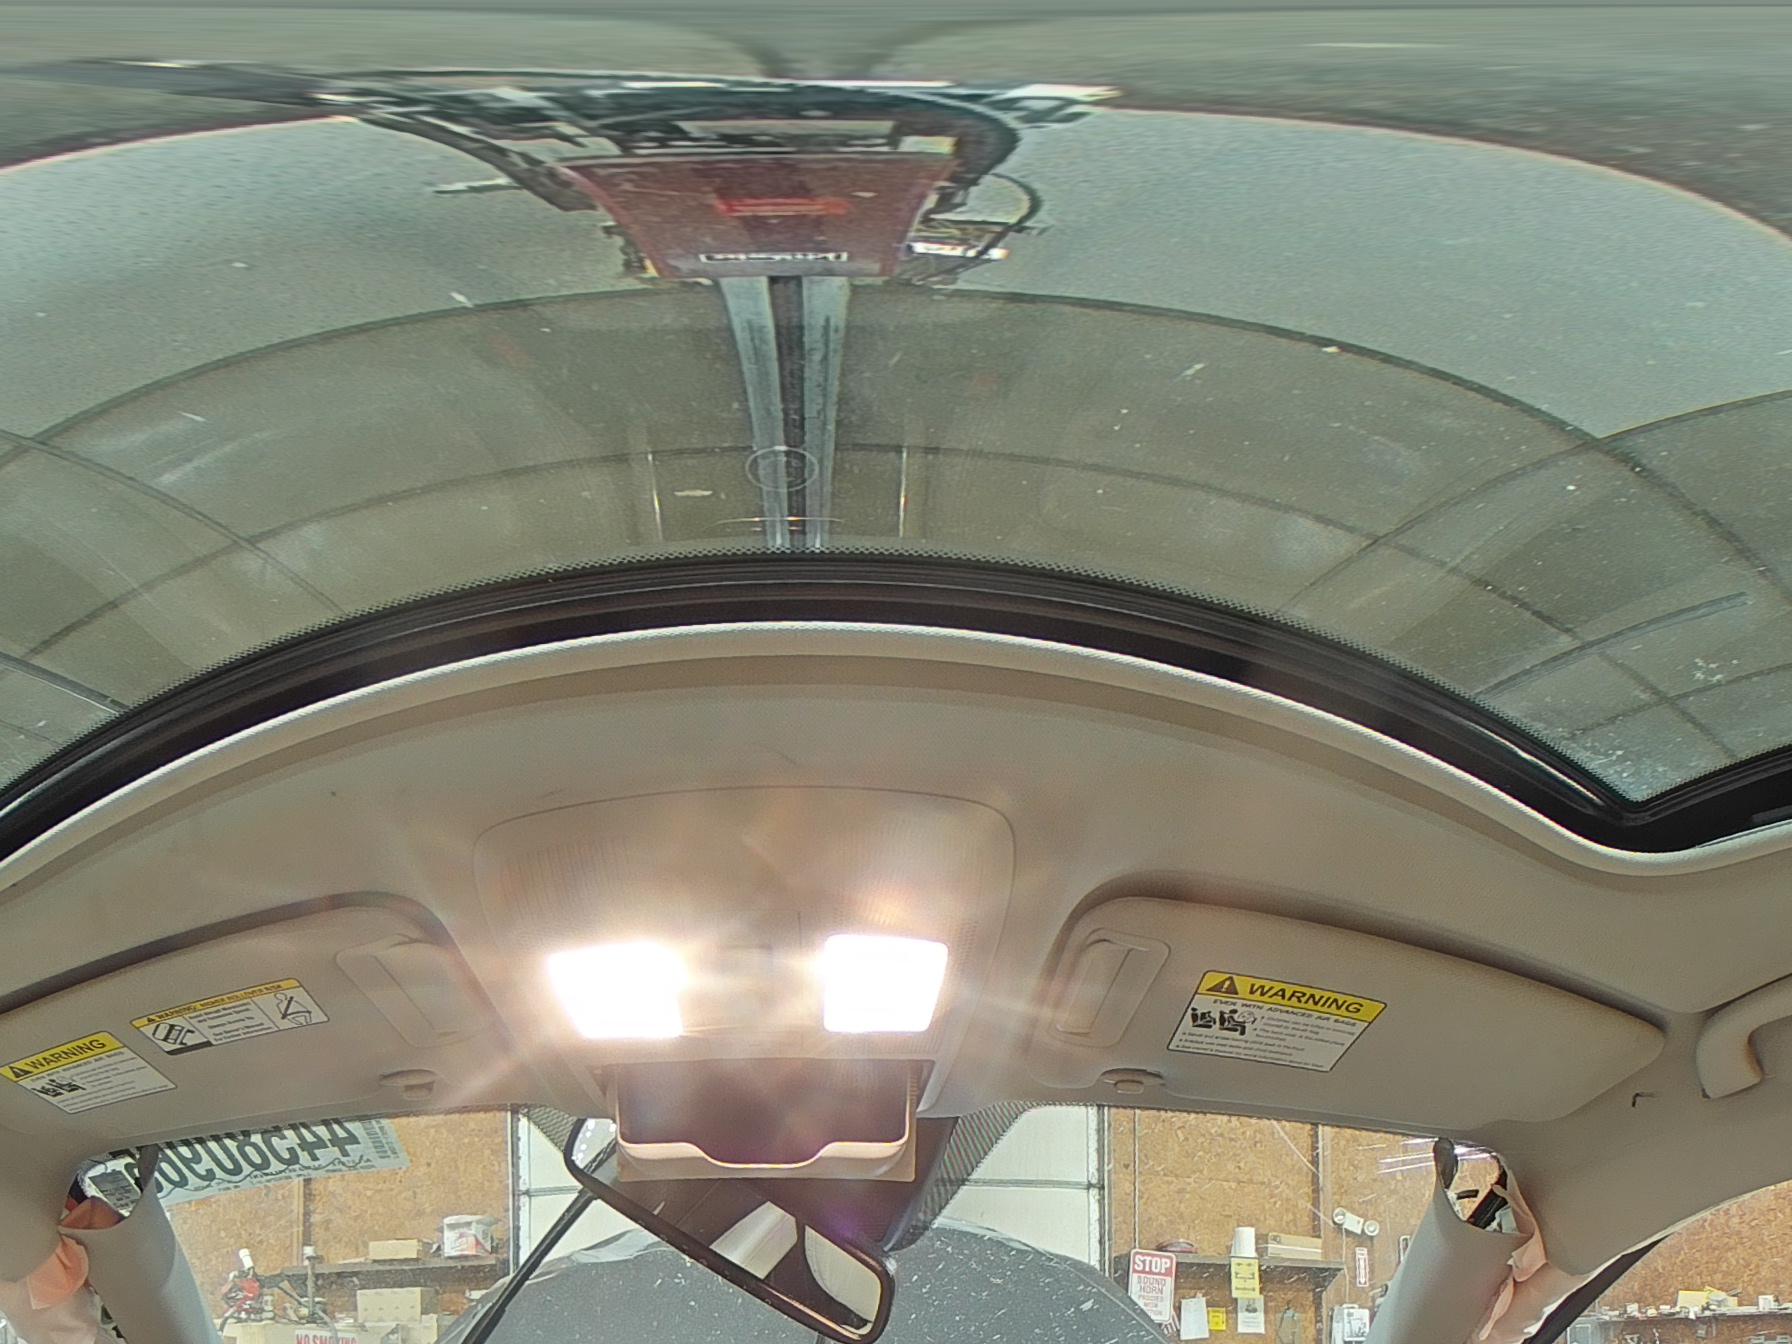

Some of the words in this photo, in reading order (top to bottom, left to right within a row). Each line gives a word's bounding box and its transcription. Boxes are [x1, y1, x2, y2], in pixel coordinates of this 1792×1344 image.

[1248, 983, 1364, 1015] WARNING
[25, 1038, 107, 1070] WARNING
[1134, 1254, 1170, 1273] STOP
